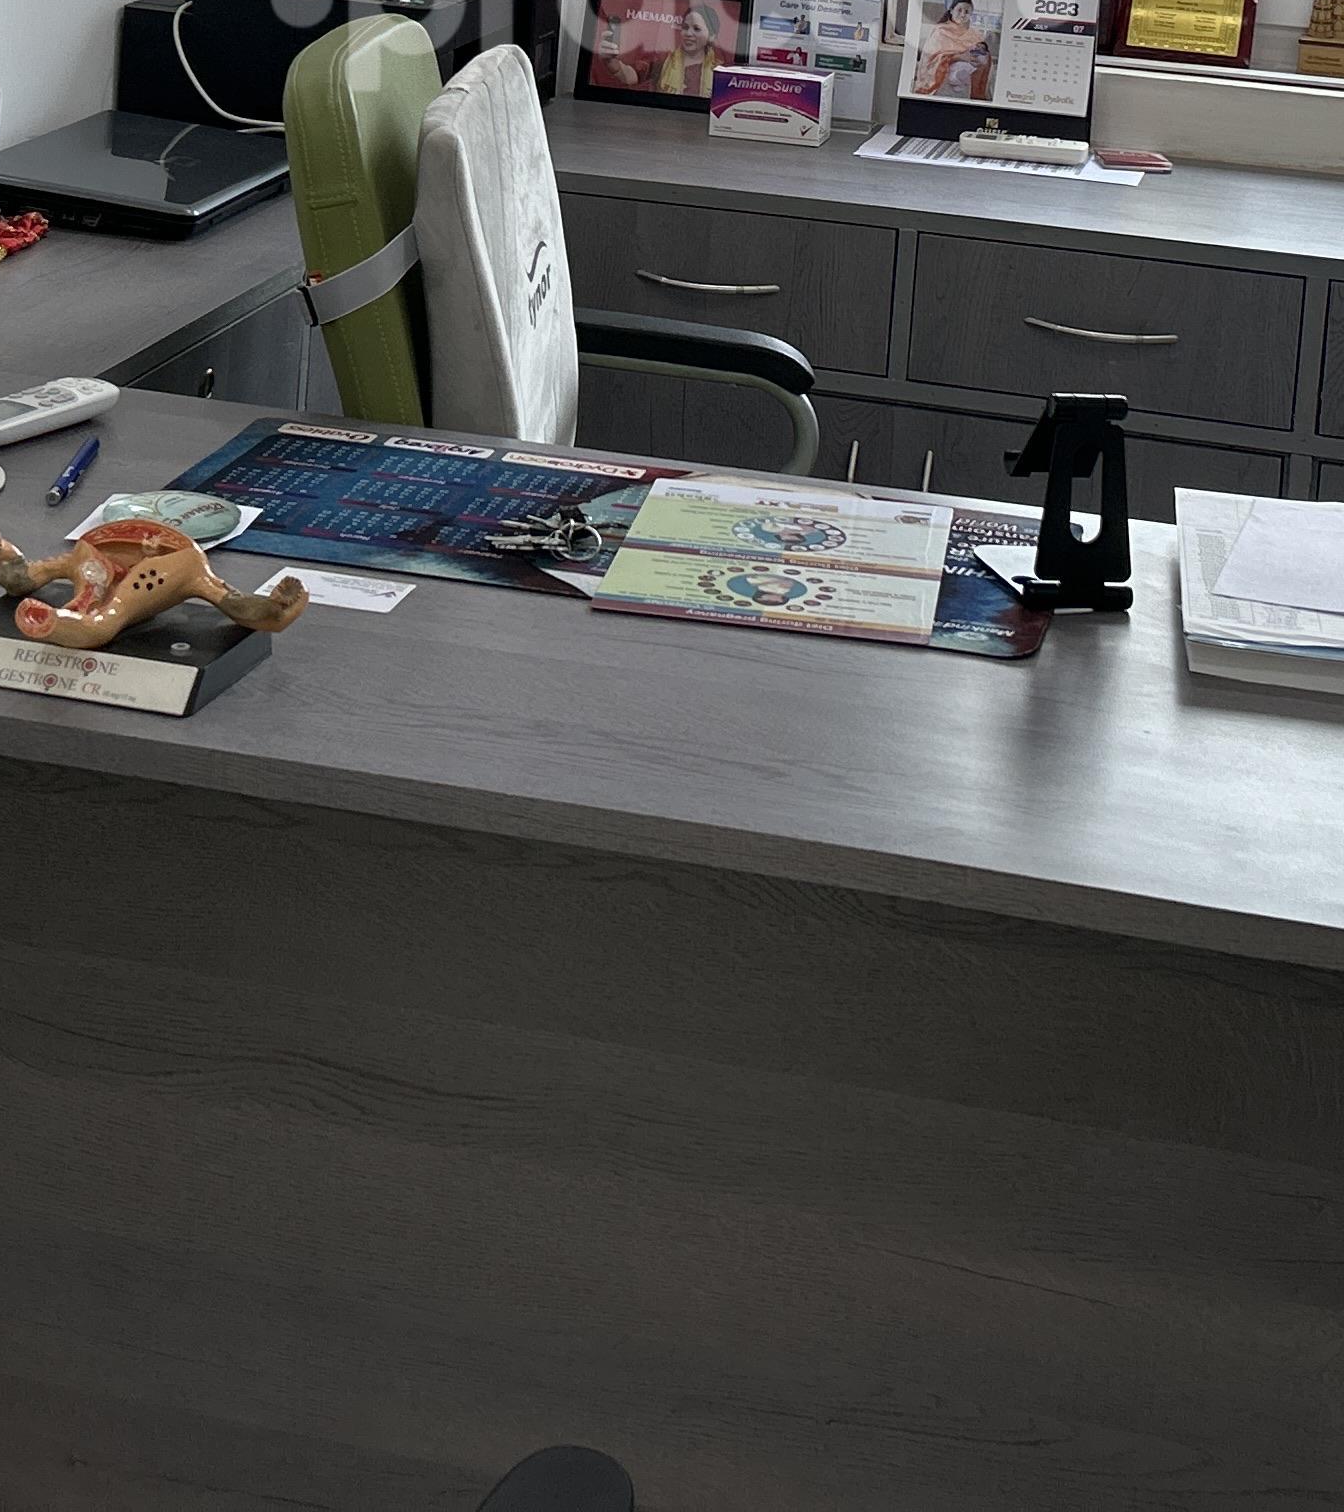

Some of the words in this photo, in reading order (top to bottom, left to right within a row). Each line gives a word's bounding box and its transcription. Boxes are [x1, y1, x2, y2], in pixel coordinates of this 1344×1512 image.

[1035, 0, 1080, 17] 2023
[727, 76, 803, 94] Amino-Sure
[528, 263, 551, 330] tynor
[685, 608, 757, 624] pregnancy
[805, 622, 834, 632] Diet
[944, 621, 1016, 638] Mankind
[13, 647, 121, 677] REGESTRONE
[81, 680, 103, 695] CR
